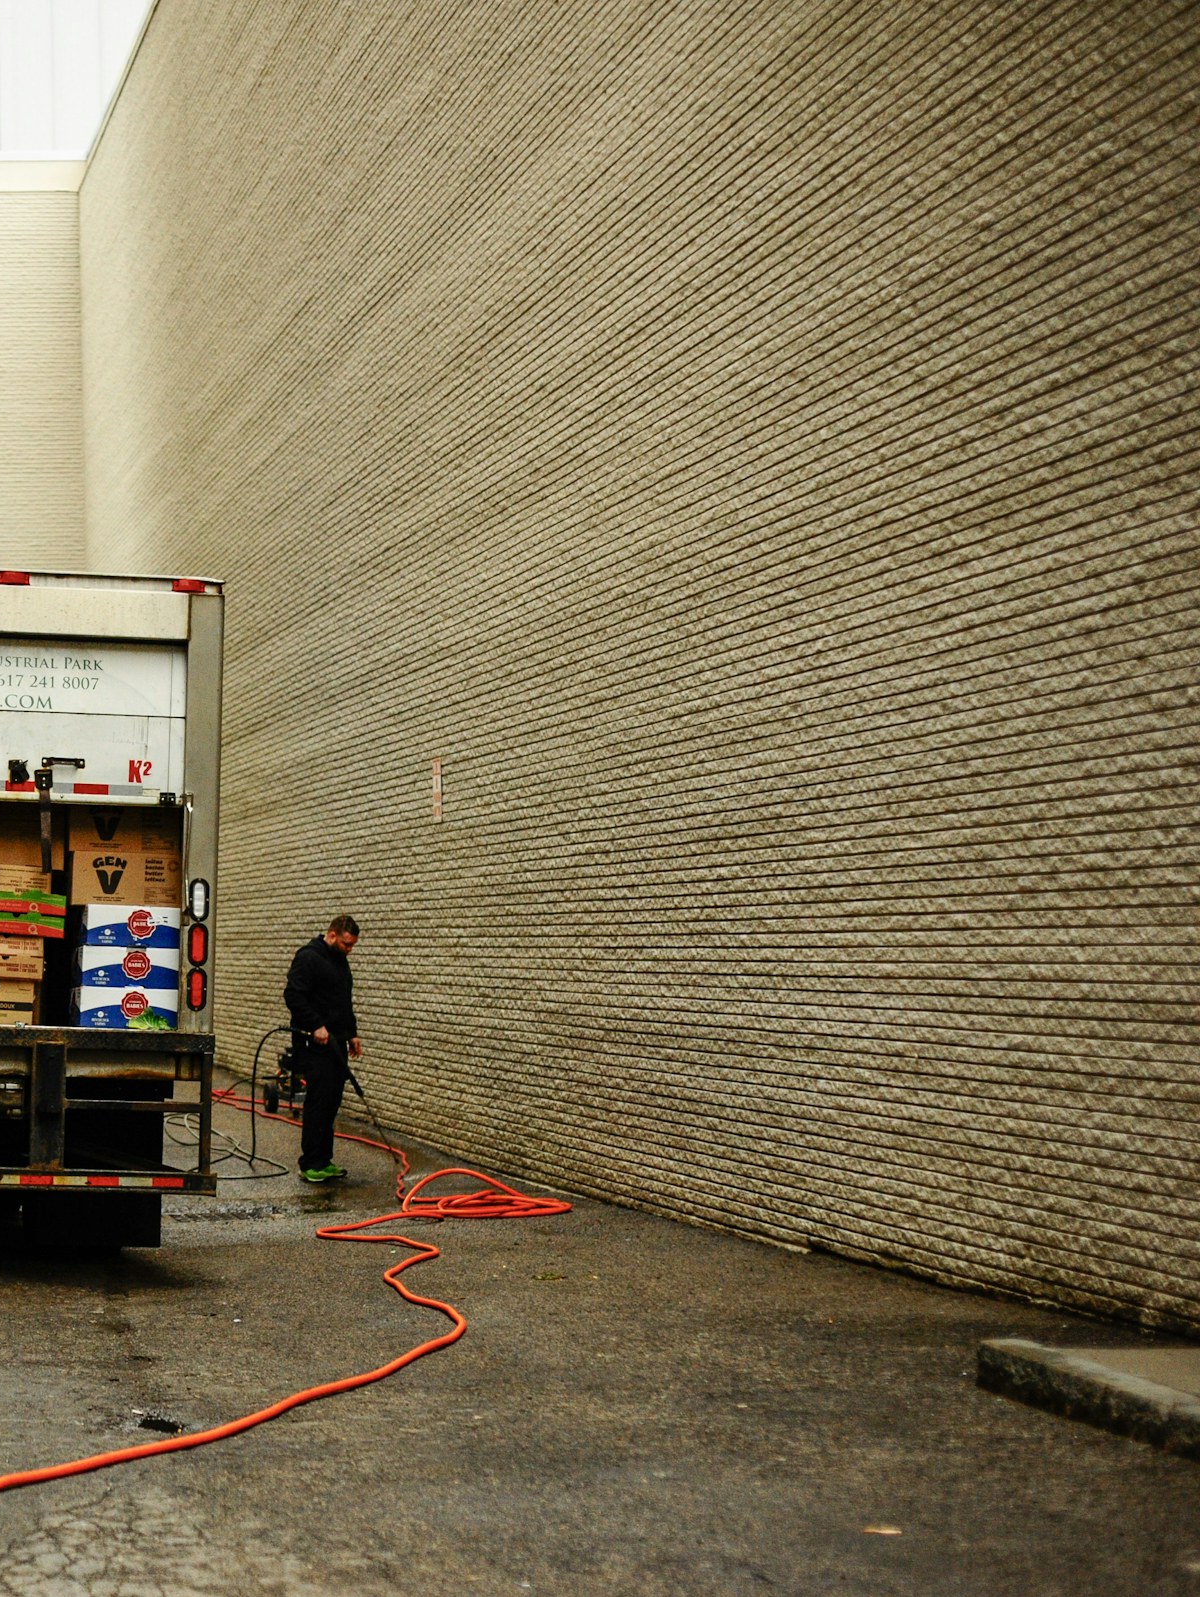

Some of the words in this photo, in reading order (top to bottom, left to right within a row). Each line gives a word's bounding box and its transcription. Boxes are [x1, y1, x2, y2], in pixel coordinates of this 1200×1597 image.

[64, 656, 104, 671] PARK
[30, 675, 55, 688] 241
[62, 676, 99, 690] 8007
[92, 856, 128, 869] GEN
[96, 870, 124, 894] V
